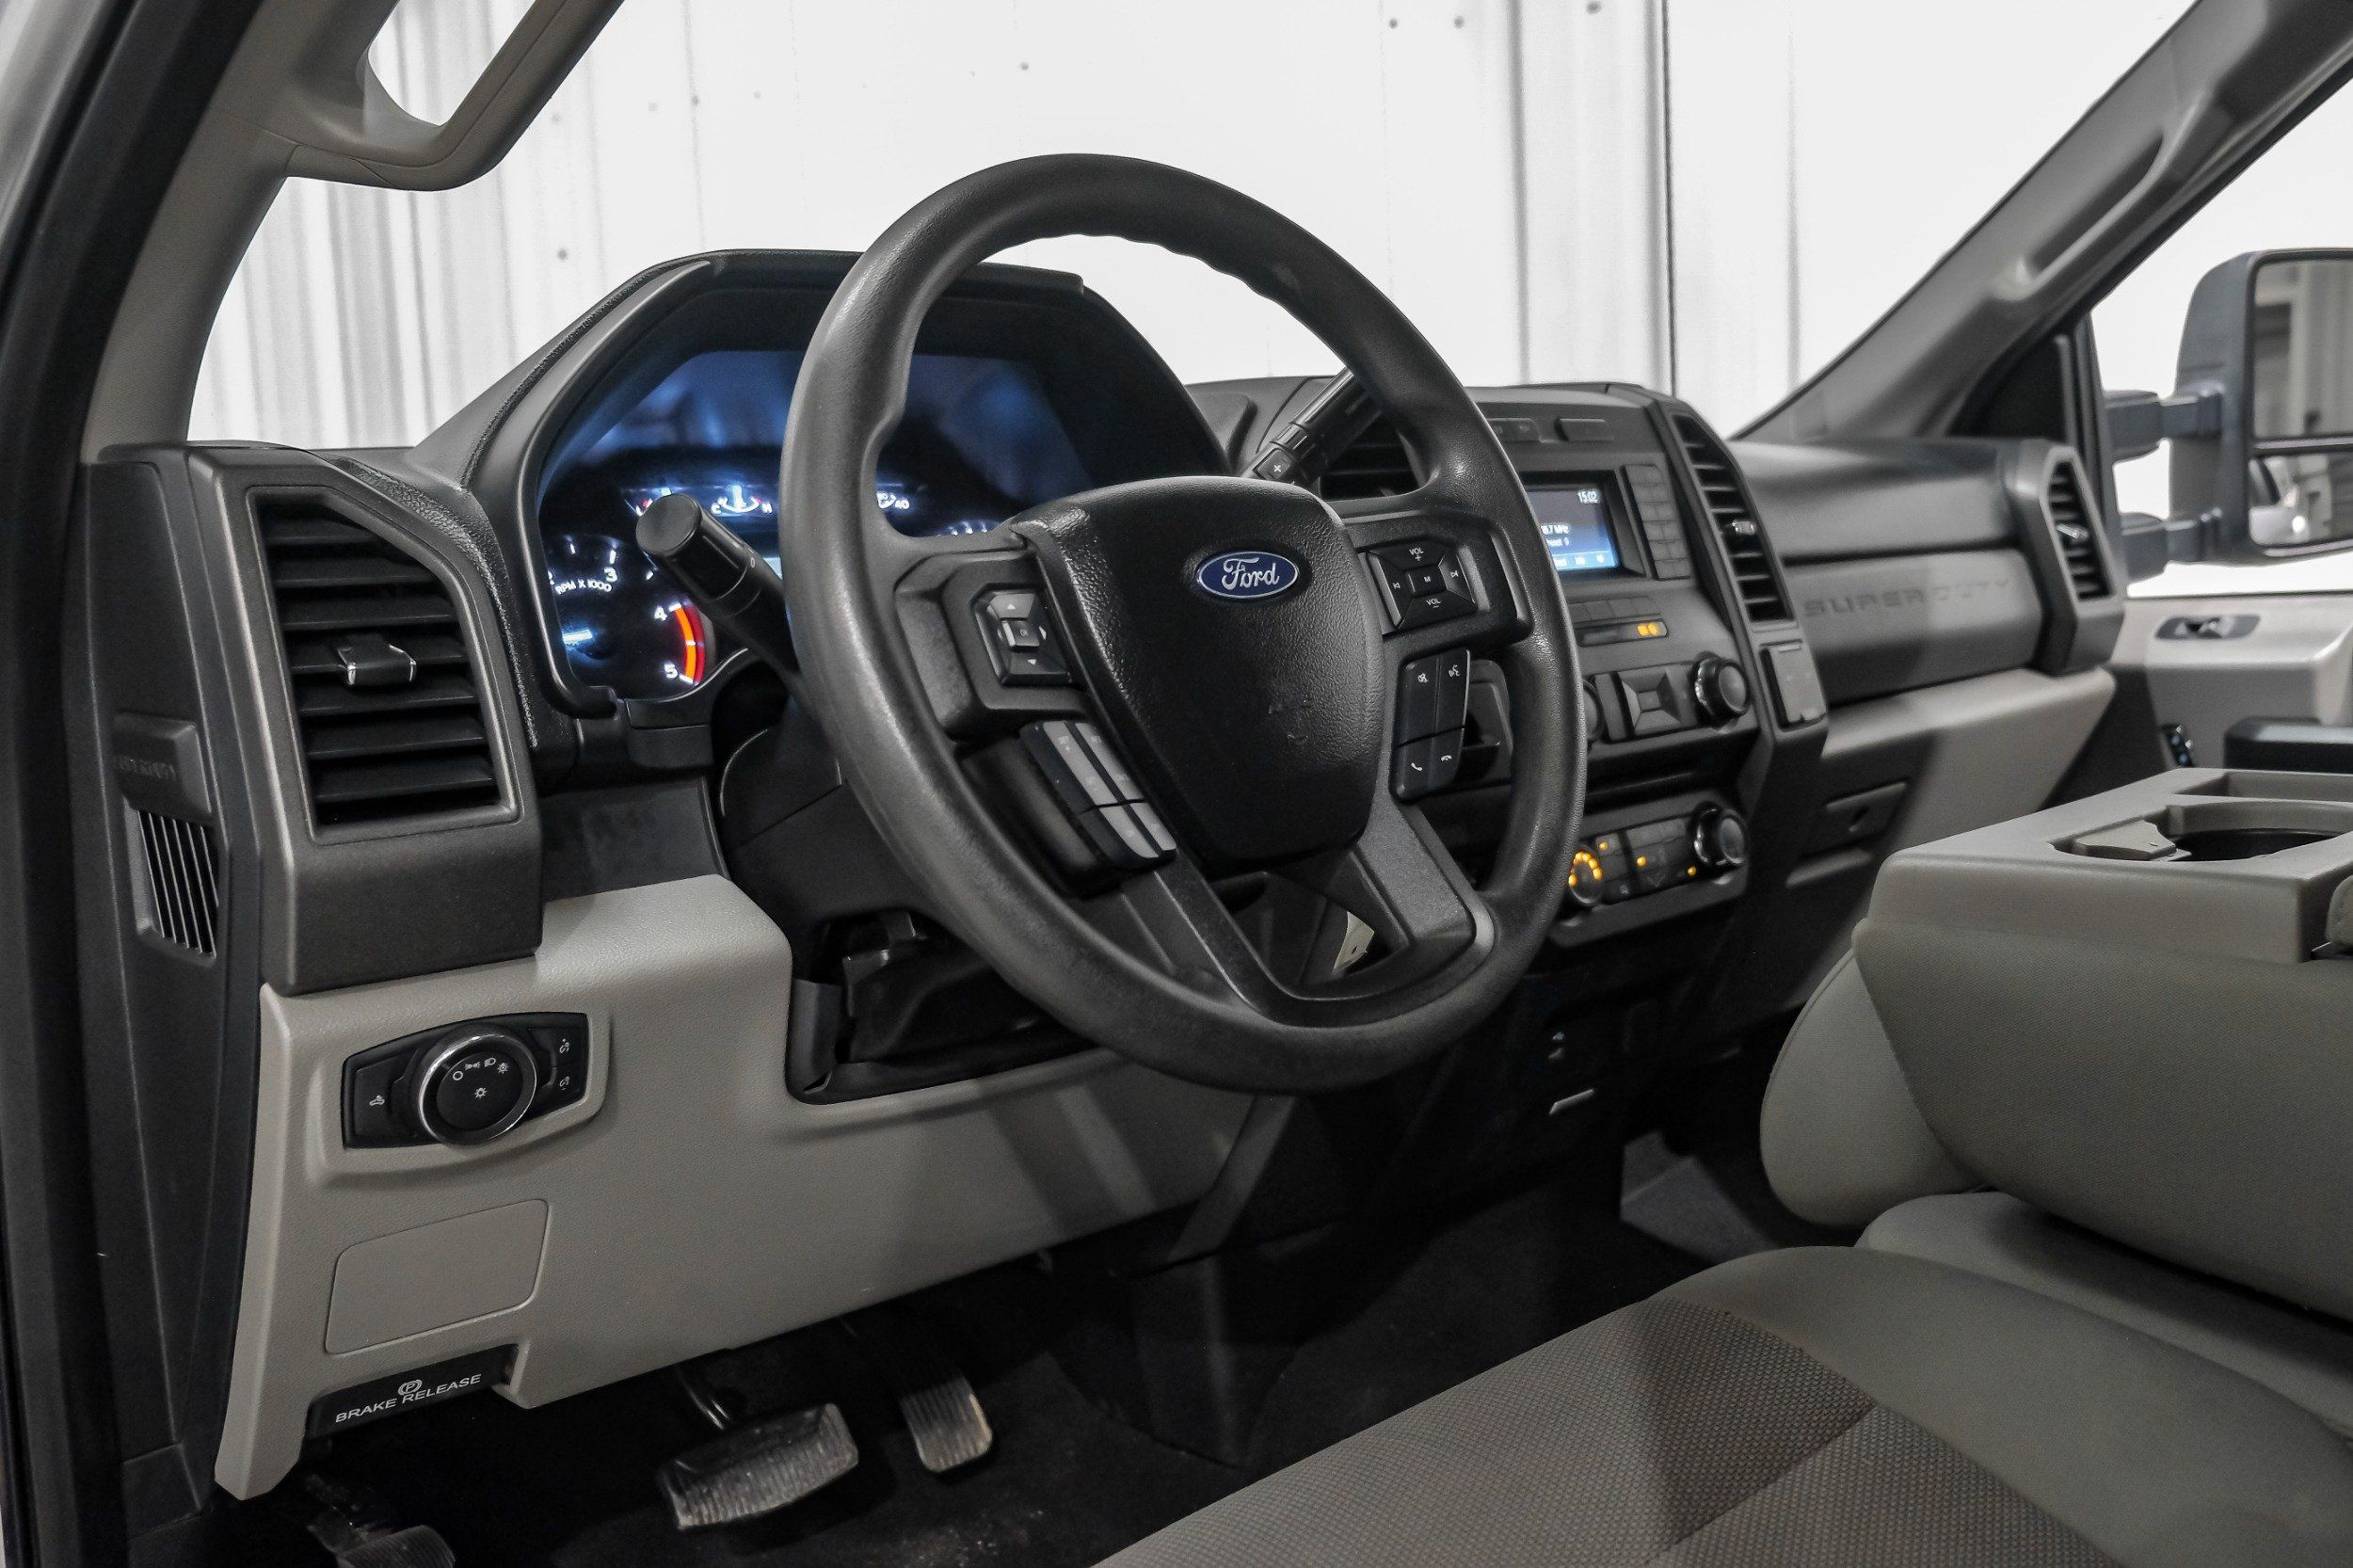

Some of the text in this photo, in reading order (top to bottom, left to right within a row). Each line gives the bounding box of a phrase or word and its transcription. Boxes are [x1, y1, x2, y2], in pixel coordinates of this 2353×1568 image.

[1408, 547, 1425, 555] VOL
[603, 567, 618, 583] 3
[1221, 557, 1280, 591] Ford
[554, 579, 613, 595] RPM X 1000
[1426, 598, 1442, 606] VOL
[654, 605, 668, 621] 4
[664, 663, 679, 679] 5
[335, 1373, 483, 1423] BRAKE RELEASE
